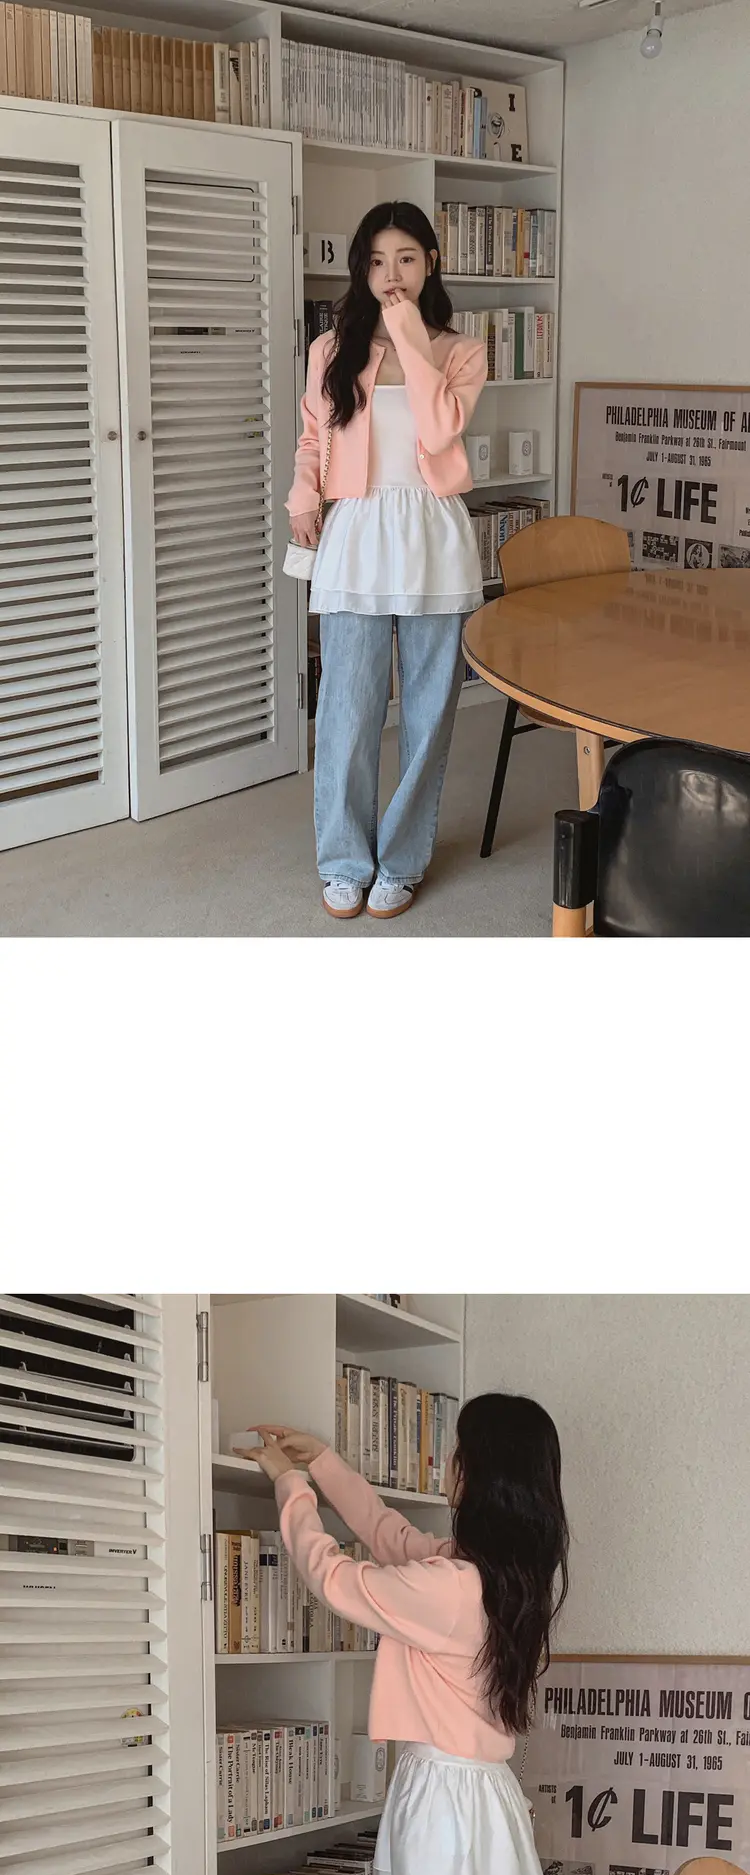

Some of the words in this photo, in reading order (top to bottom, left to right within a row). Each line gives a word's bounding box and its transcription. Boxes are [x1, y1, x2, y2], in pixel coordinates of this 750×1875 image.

[321, 239, 335, 264] B
[606, 405, 669, 428] PHILADELPHIA
[673, 408, 717, 431] MUSEUM
[723, 411, 736, 432] OF
[615, 431, 637, 443] Benjamin
[638, 432, 660, 445] Franklin
[661, 433, 684, 448] Parkway
[685, 436, 691, 447] at
[692, 437, 706, 448] 26th
[718, 438, 747, 452] Fairmount
[646, 451, 659, 463] JULY
[698, 455, 712, 467] 1965
[617, 474, 649, 512] 1¢
[656, 478, 718, 525] LIFE
[544, 1687, 651, 1717] PHILADELPHIA
[659, 1690, 733, 1719] MUSEUM
[561, 1724, 597, 1740] Benjamin
[601, 1726, 635, 1742] Franklin
[639, 1727, 676, 1744] Parkway
[680, 1730, 689, 1744] at
[692, 1730, 713, 1745] 26th
[717, 1730, 732, 1747] St.,
[614, 1751, 634, 1766] JULY
[639, 1753, 681, 1769] 1-AUGUST
[686, 1755, 698, 1771] 31,
[703, 1755, 723, 1770] 1965
[538, 1784, 557, 1794] ARTISTS
[226, 1804, 234, 1824] Lady
[565, 1785, 618, 1839] 1¢
[632, 1788, 734, 1851] LIFE
